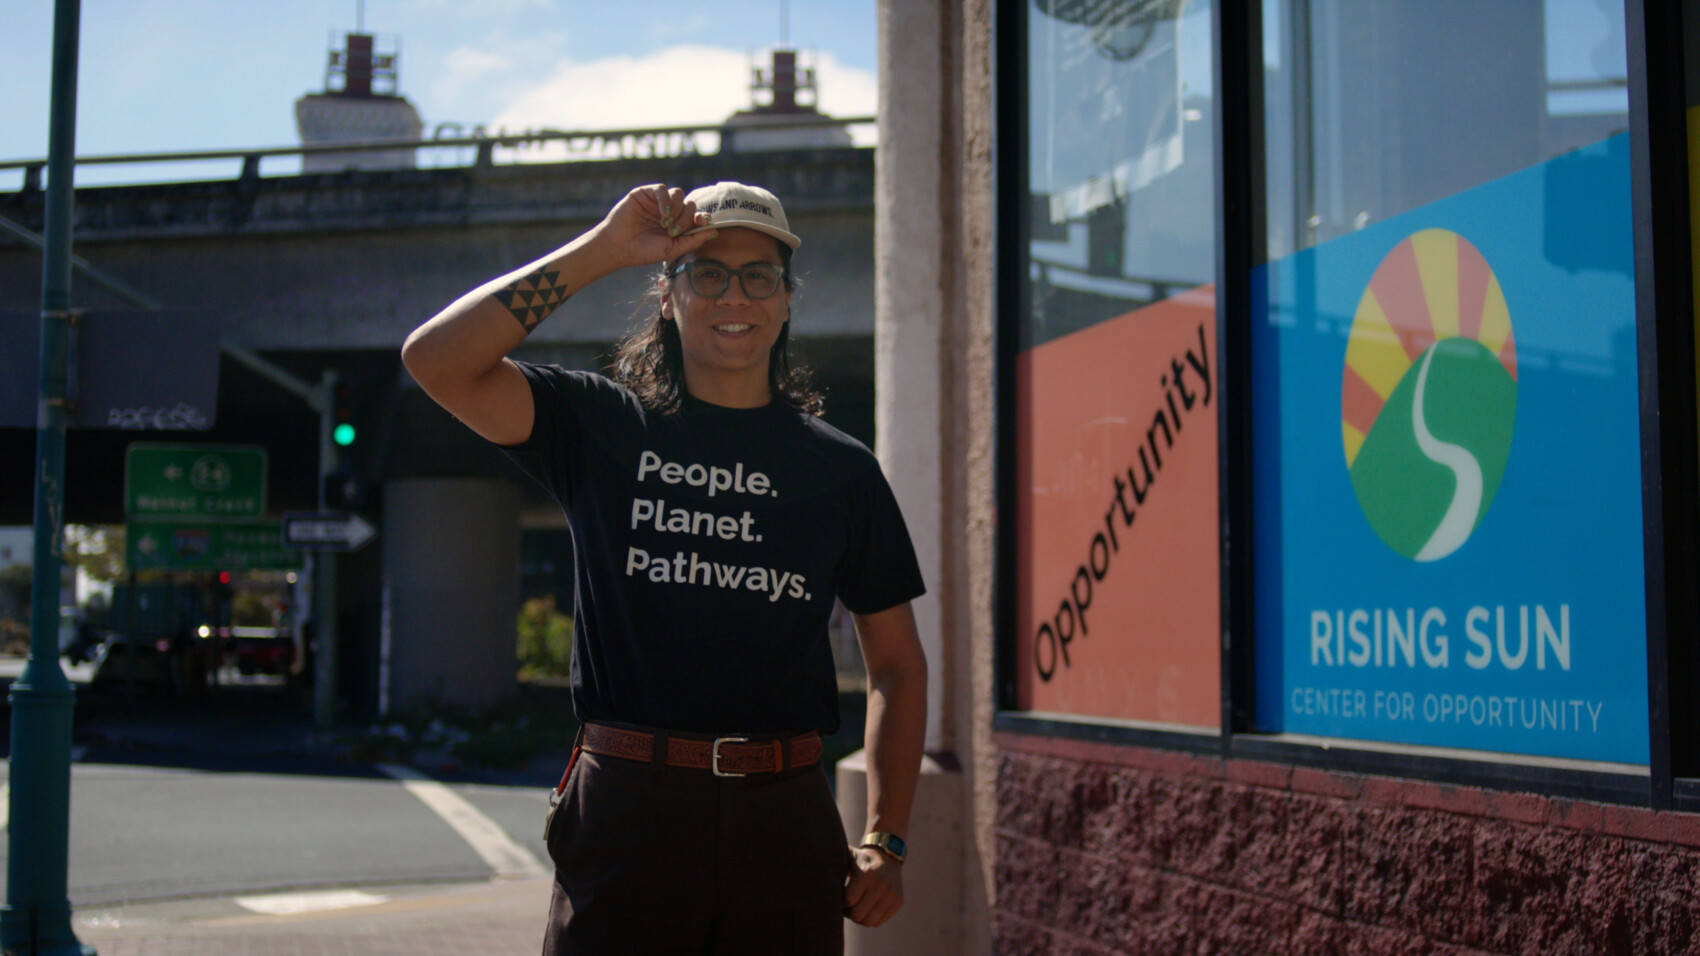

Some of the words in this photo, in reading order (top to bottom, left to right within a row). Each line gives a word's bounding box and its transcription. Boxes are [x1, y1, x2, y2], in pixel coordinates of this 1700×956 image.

[696, 203, 719, 213] OWS
[720, 199, 738, 210] AND
[637, 450, 778, 497] People.
[631, 498, 763, 542] Planet.
[1034, 323, 1213, 683] Opportunity
[626, 546, 812, 602] Pathways.
[1310, 606, 1449, 669] RISING
[1464, 603, 1571, 671] SUN
[1291, 687, 1366, 719] CENTER
[1374, 690, 1415, 721] FOR
[1423, 693, 1602, 734] OPPORTUNITY
